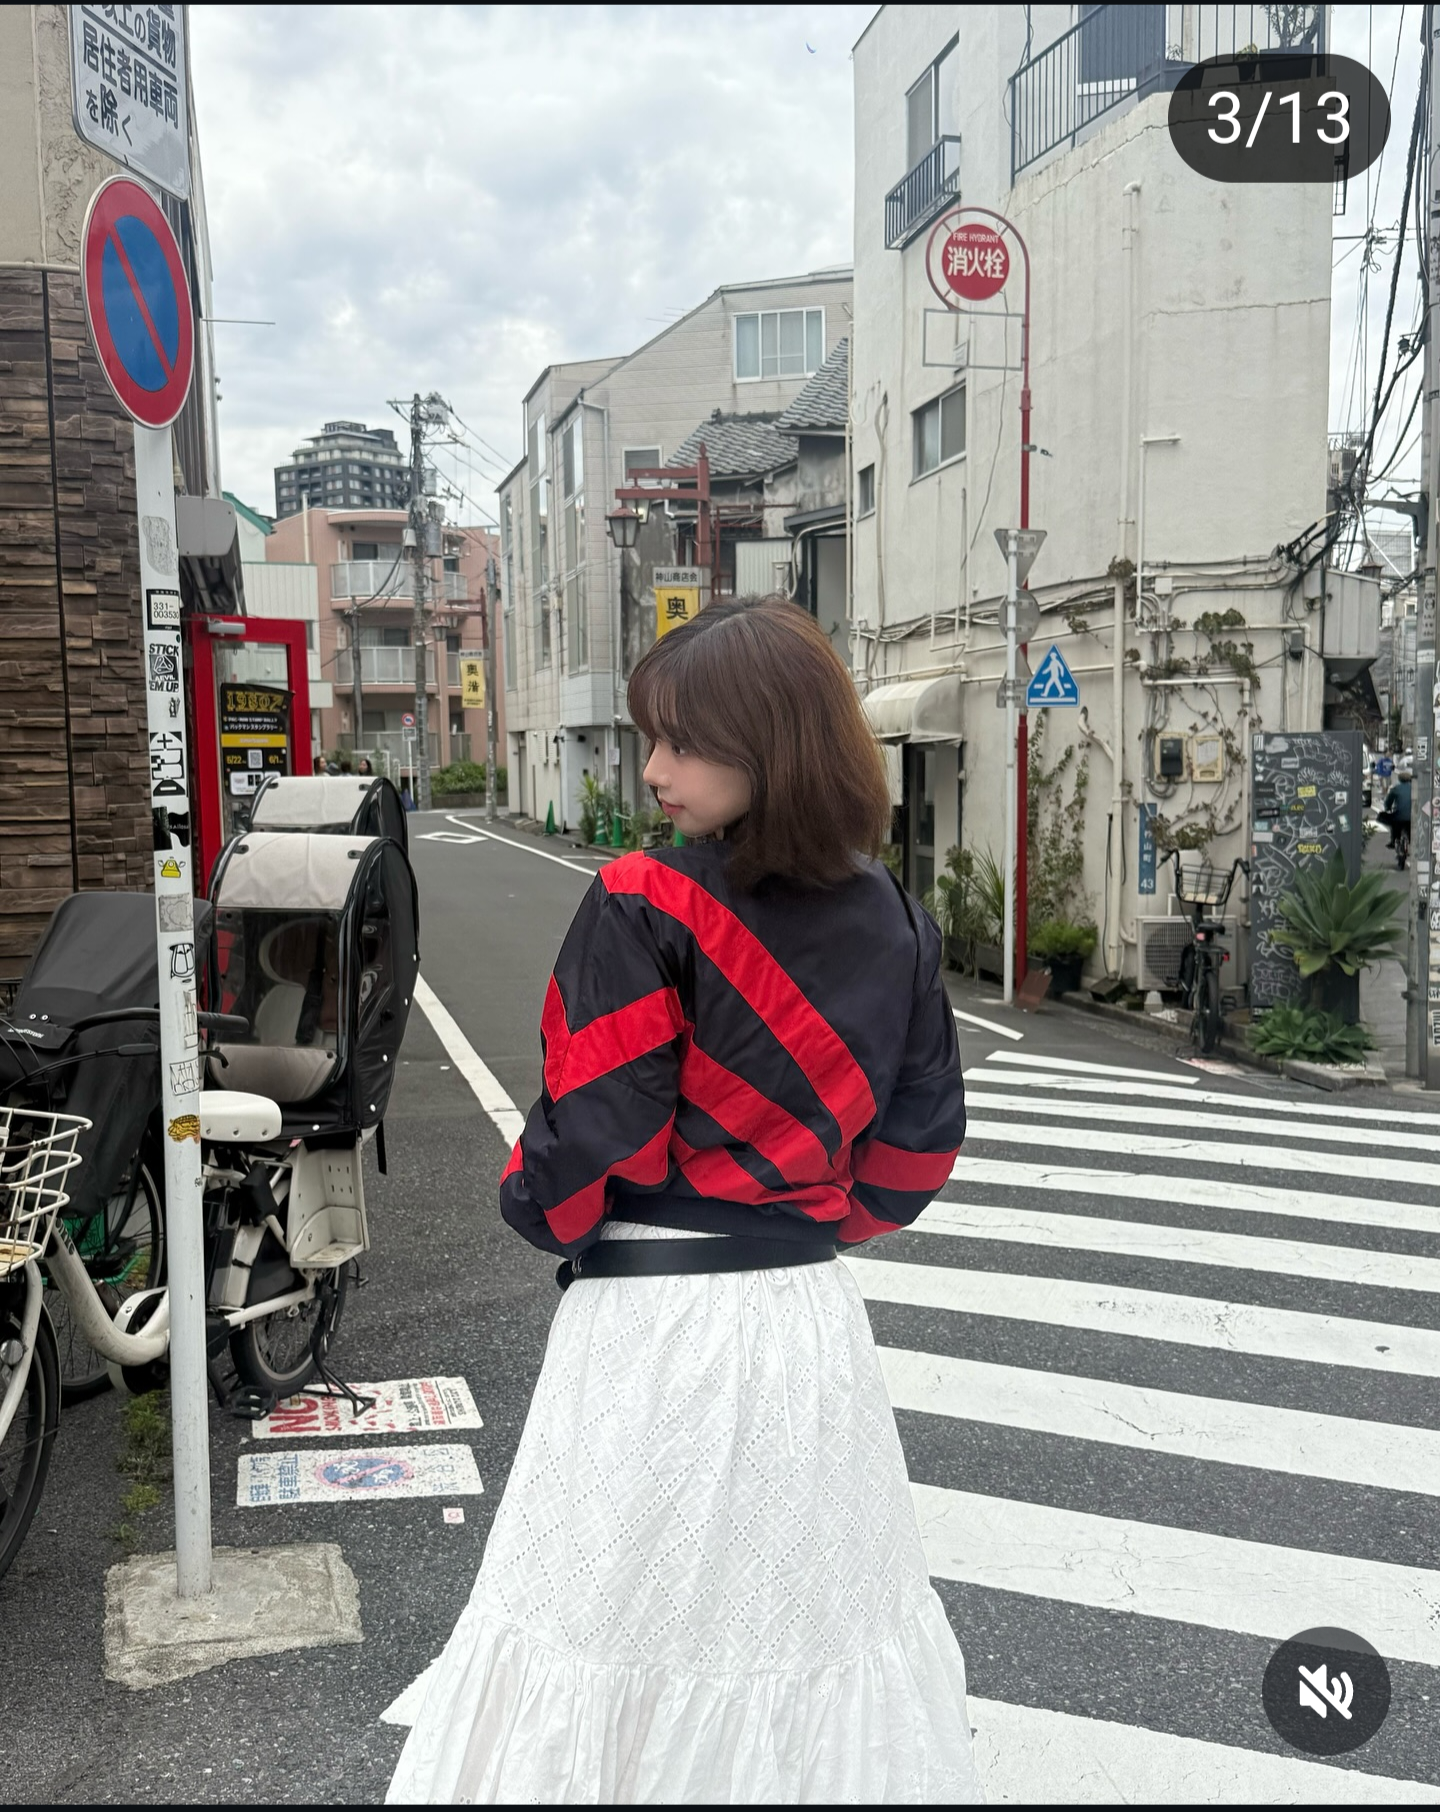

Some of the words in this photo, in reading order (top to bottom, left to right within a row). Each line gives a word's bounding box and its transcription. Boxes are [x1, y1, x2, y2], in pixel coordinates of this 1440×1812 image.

[83, 20, 178, 130] 居住者用車両
[86, 84, 132, 147] を除く
[953, 232, 967, 242] FIRE
[969, 233, 999, 244] HYDRANT
[947, 246, 1006, 279] 消火栓
[655, 572, 698, 583] 神山商店会
[666, 597, 689, 620] 奥
[149, 643, 179, 656] STICK
[166, 682, 179, 692] UP
[1140, 878, 1154, 889] 43
